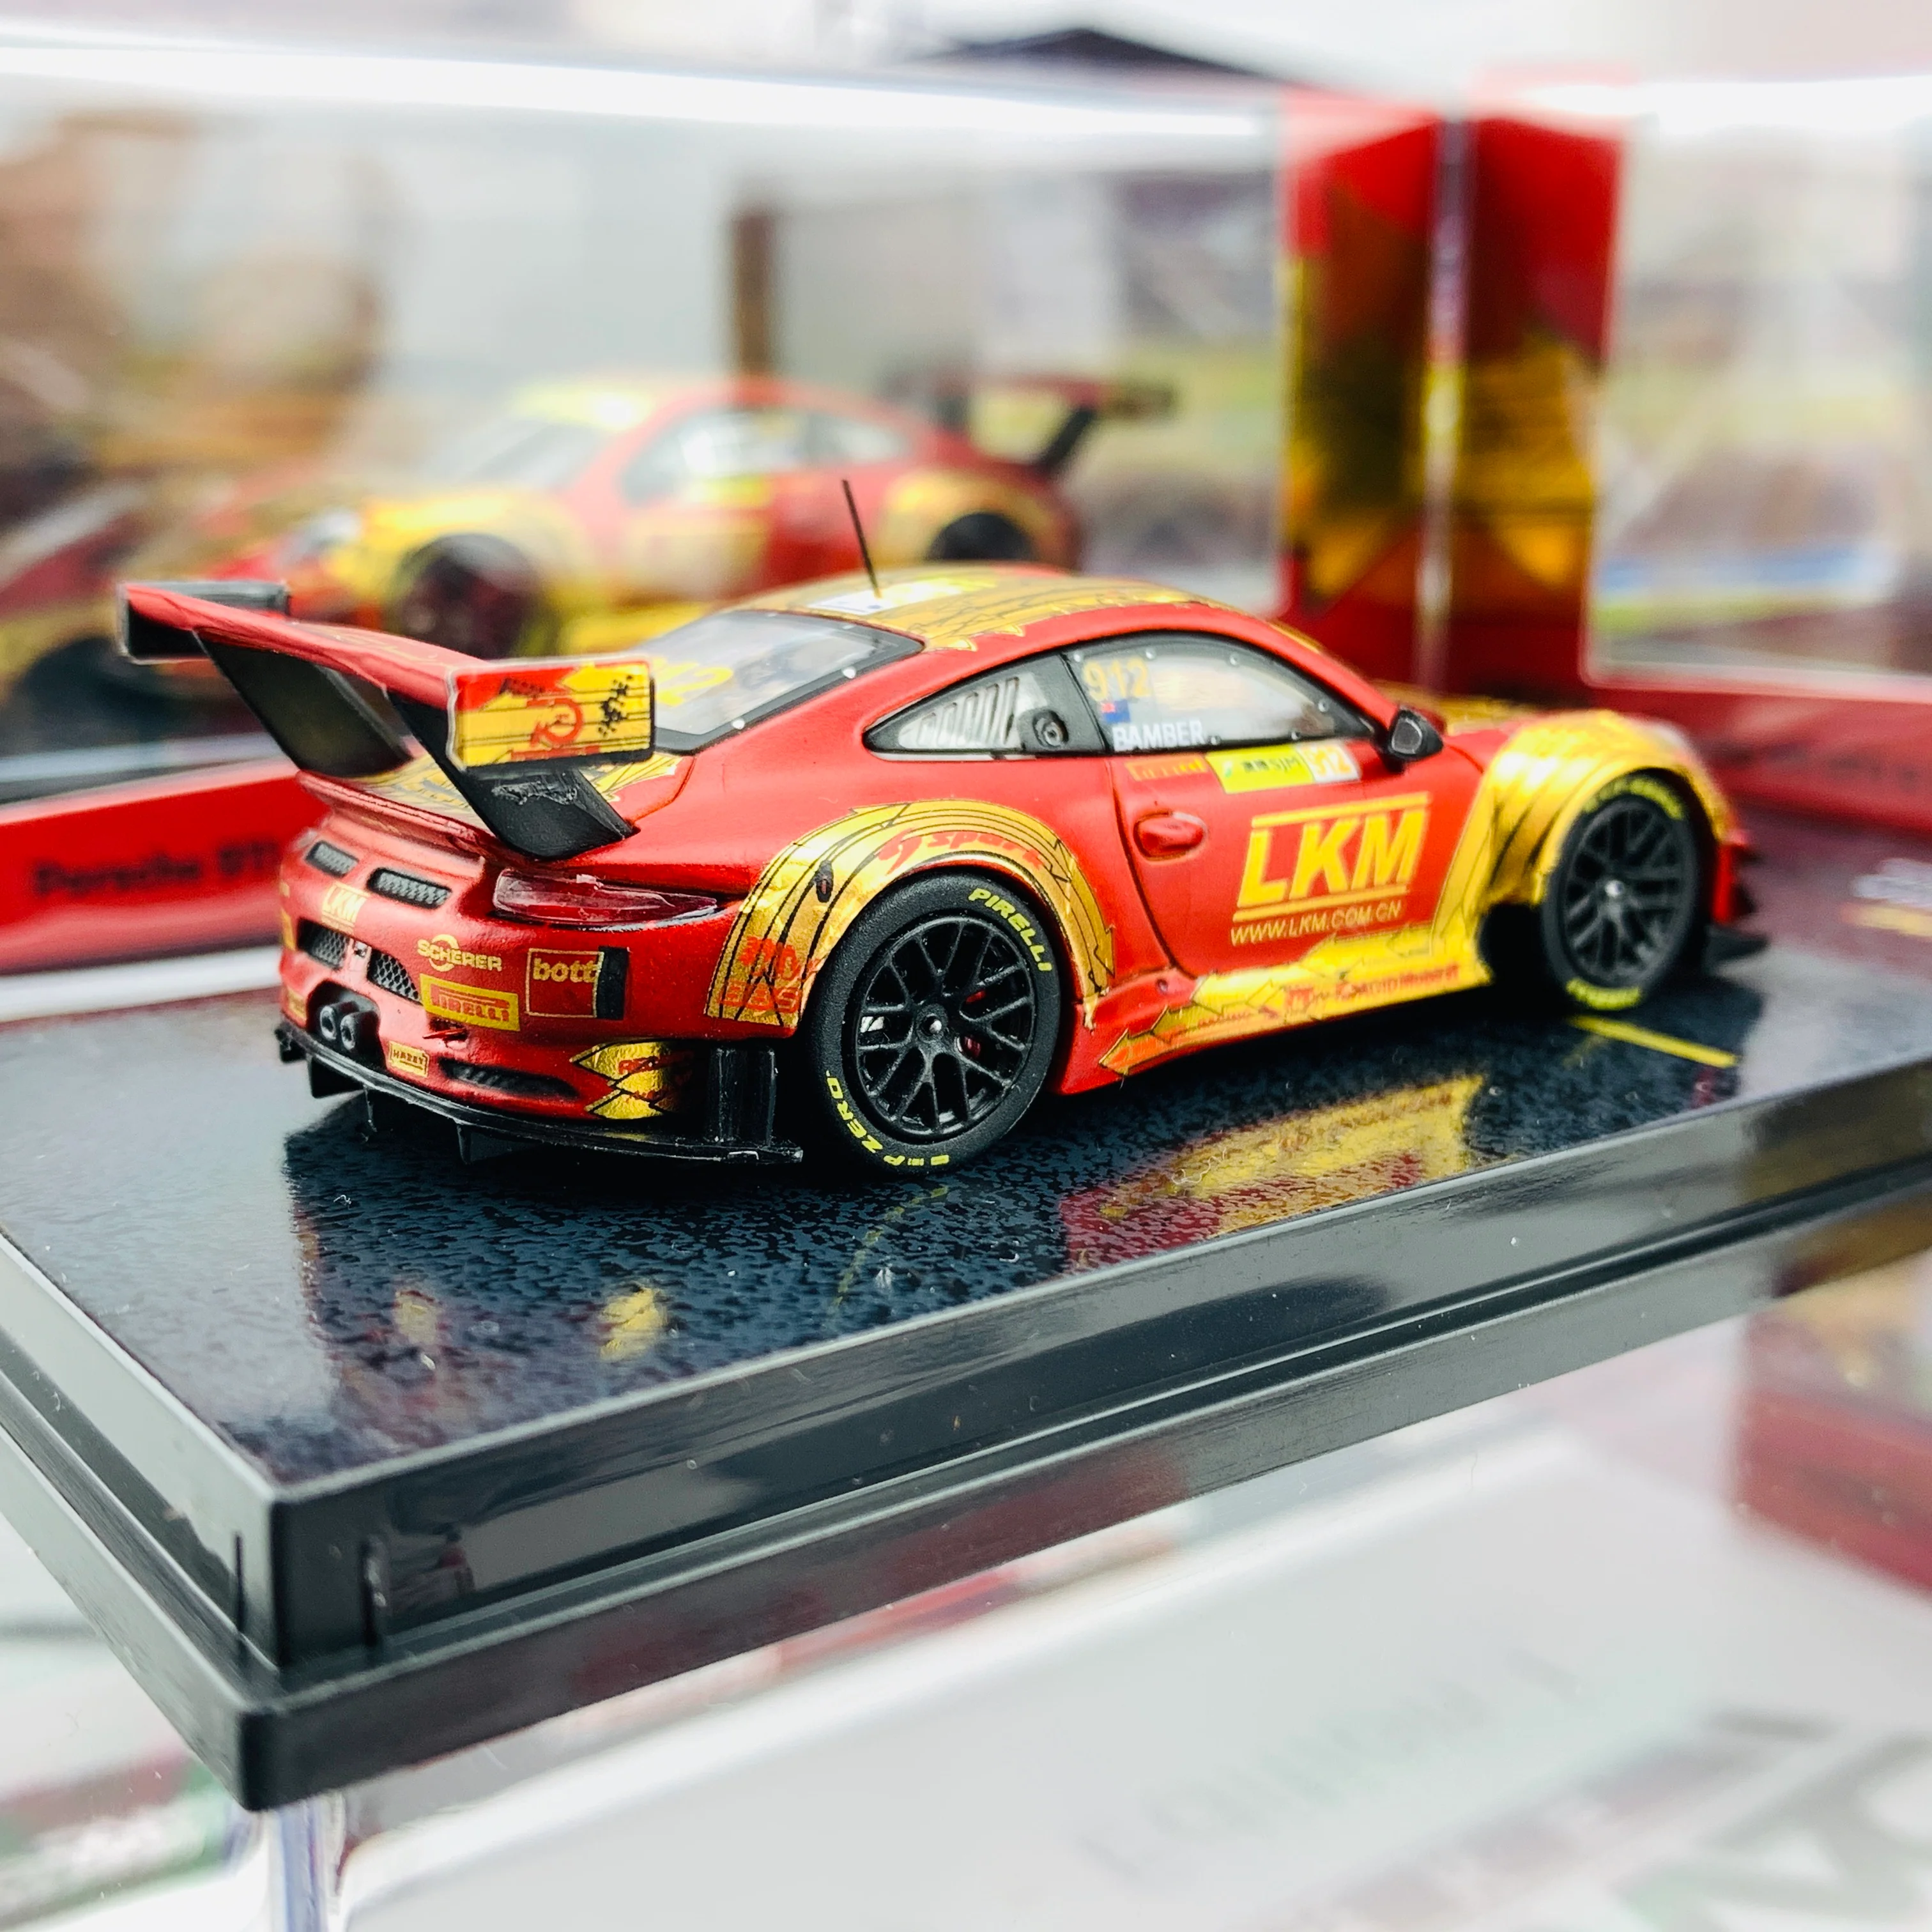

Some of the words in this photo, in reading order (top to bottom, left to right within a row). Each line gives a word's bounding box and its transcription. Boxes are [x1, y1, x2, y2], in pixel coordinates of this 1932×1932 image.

[1083, 656, 1149, 702] 912
[1112, 719, 1206, 752] BAMBER
[1238, 808, 1429, 908] LKM
[967, 887, 1052, 971] PIRELLI
[1230, 900, 1402, 946] WWW.LKM.COM.CN
[417, 939, 502, 972] SCHERER
[533, 958, 600, 983] bott
[429, 983, 510, 1022] PIRELLI
[826, 1076, 884, 1154] ZERO
[883, 1155, 906, 1167] P
